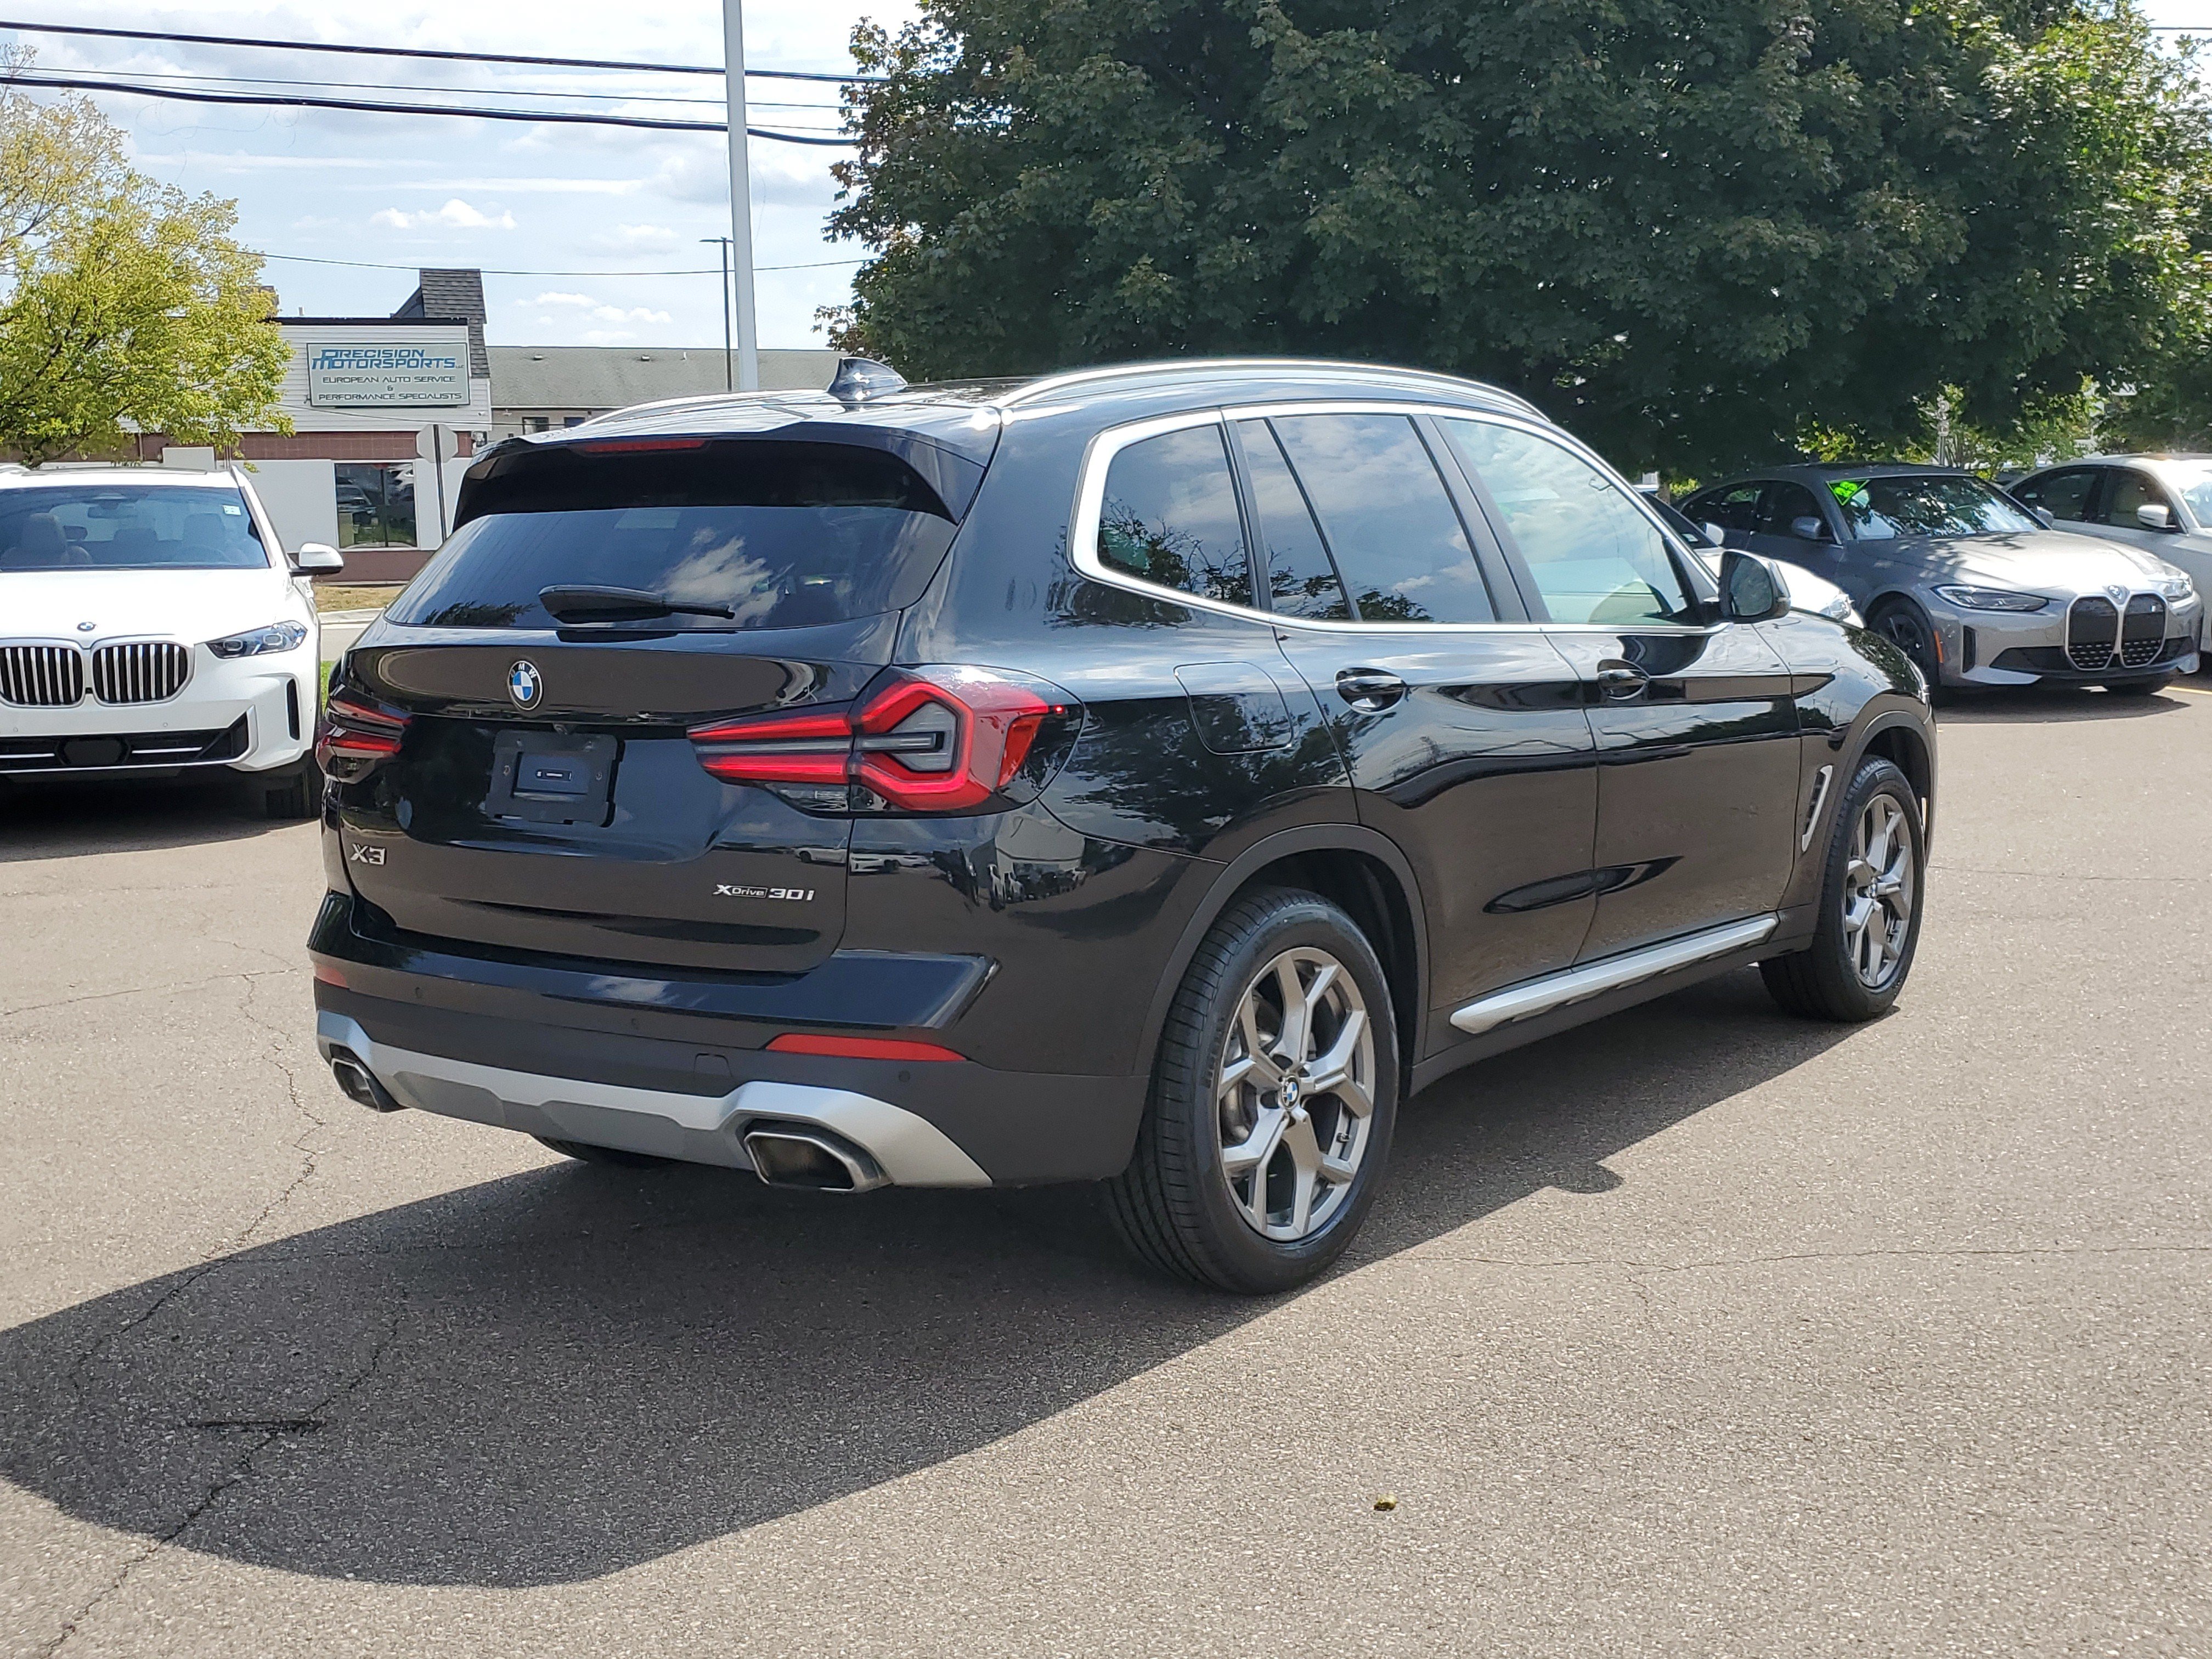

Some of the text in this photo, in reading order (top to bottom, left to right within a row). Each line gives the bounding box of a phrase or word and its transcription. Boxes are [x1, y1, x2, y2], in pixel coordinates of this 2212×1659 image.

[321, 349, 425, 358] PRECISION
[312, 358, 456, 370] MOTORSPORTS
[511, 663, 537, 679] BMW
[350, 843, 386, 865] X3
